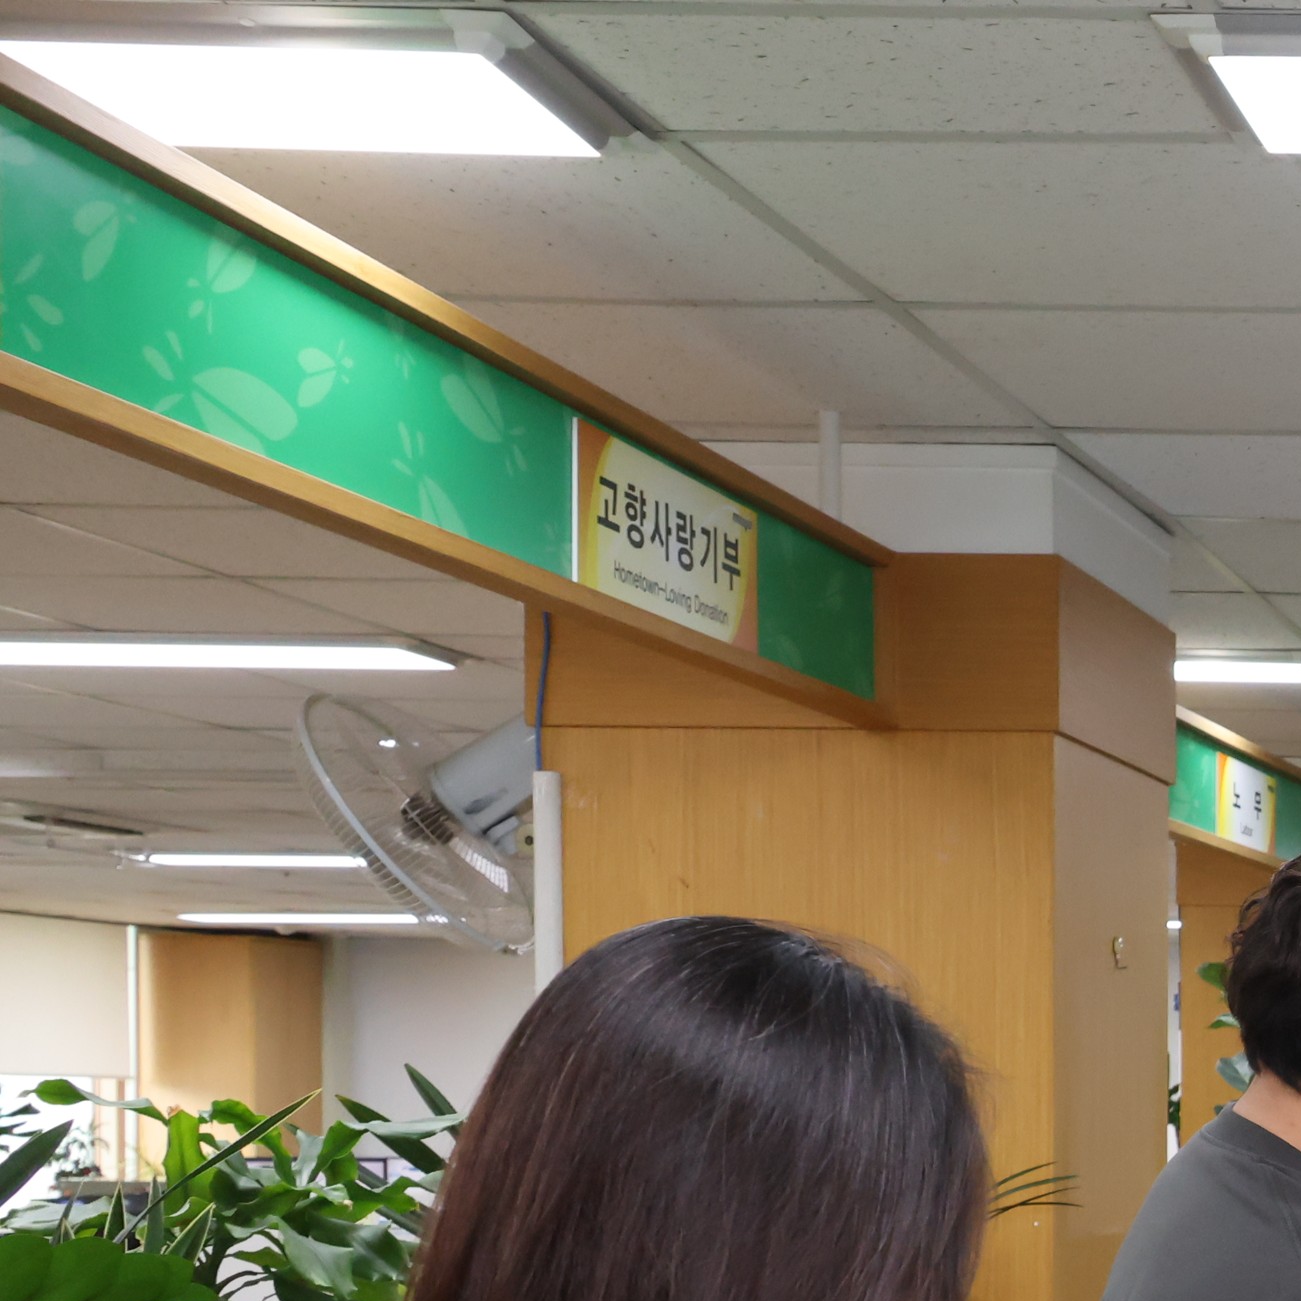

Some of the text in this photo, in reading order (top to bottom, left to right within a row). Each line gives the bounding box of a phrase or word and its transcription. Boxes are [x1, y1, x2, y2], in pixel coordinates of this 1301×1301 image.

[597, 475, 742, 591] 고향사랑기부
[613, 559, 729, 626] Hometown-Loving Donation
